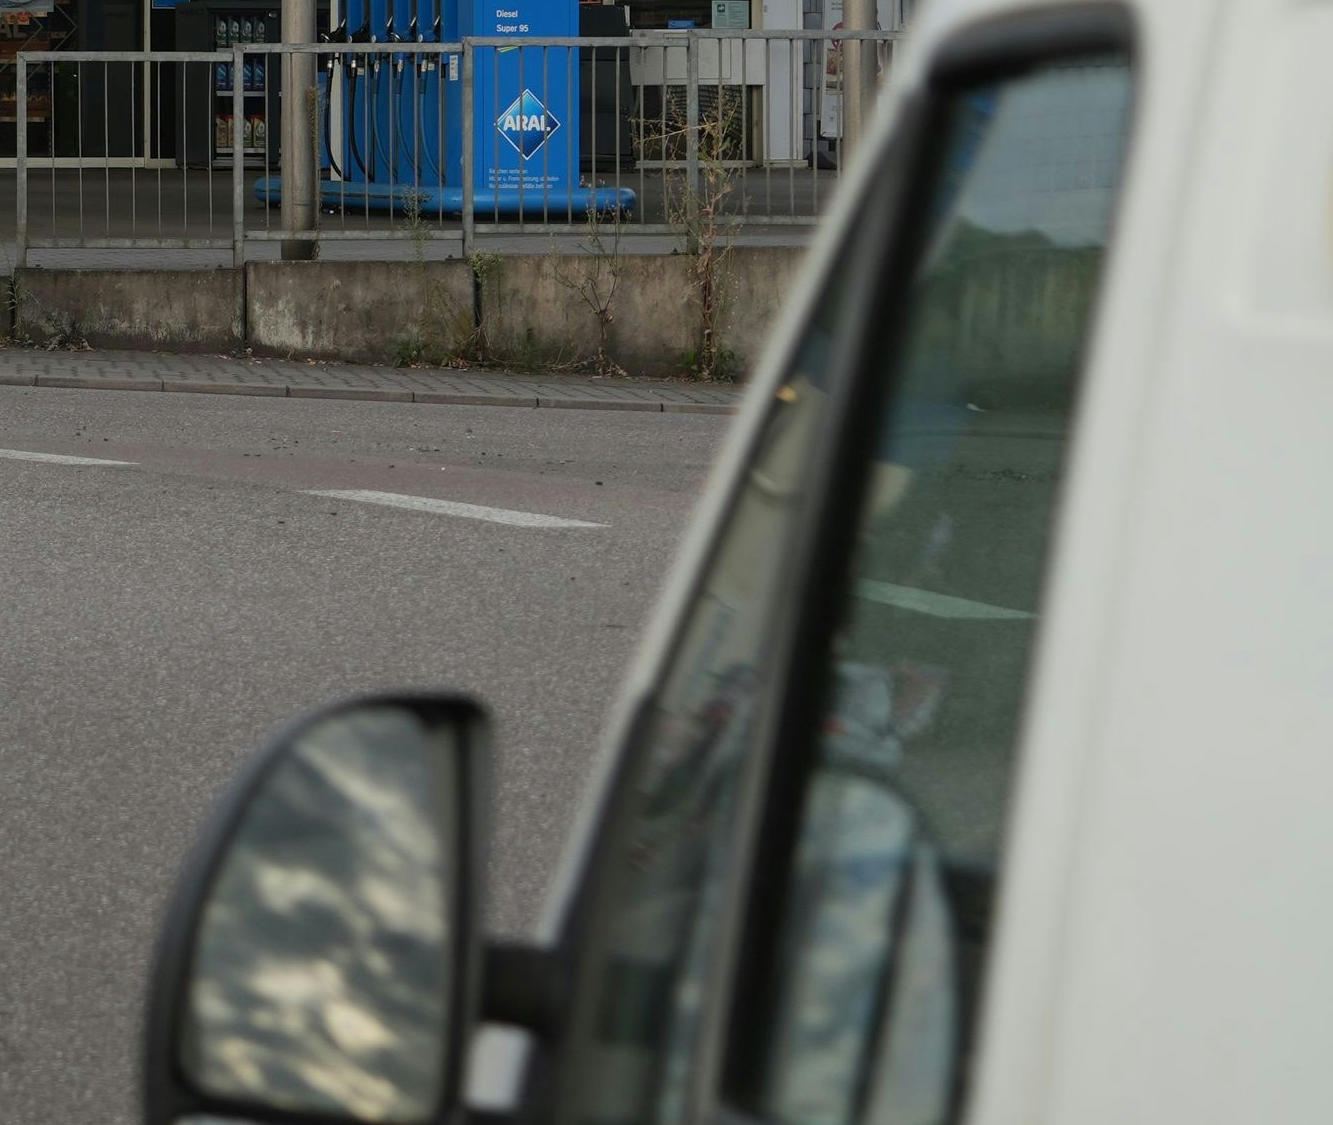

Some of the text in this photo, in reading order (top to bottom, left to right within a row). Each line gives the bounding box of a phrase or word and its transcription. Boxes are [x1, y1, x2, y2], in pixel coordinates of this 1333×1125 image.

[496, 9, 518, 18] Diesel
[496, 24, 529, 33] Super 95
